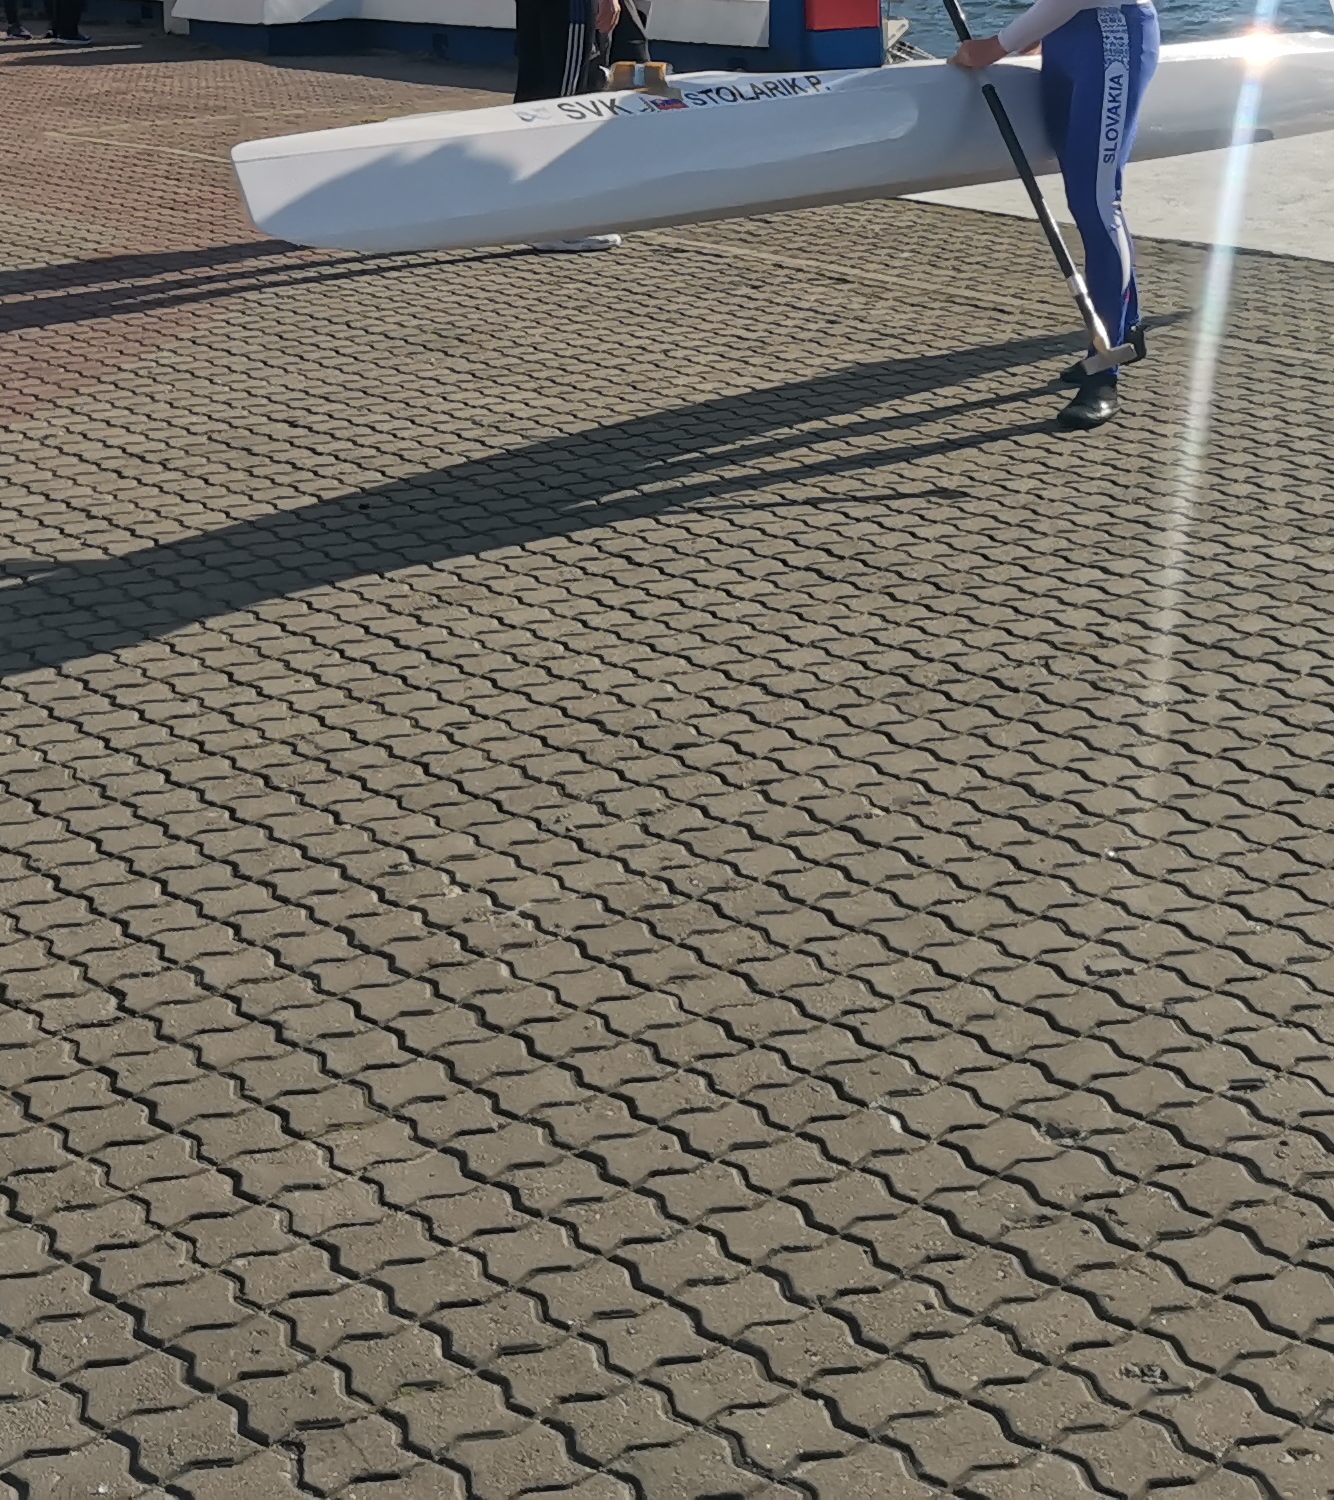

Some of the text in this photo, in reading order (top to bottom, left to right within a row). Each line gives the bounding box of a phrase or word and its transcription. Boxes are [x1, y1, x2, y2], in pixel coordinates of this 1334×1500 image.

[556, 97, 634, 120] SVK
[684, 76, 808, 107] STOLARIK
[805, 74, 832, 93] P.
[1102, 73, 1124, 165] SLOVAKIA
